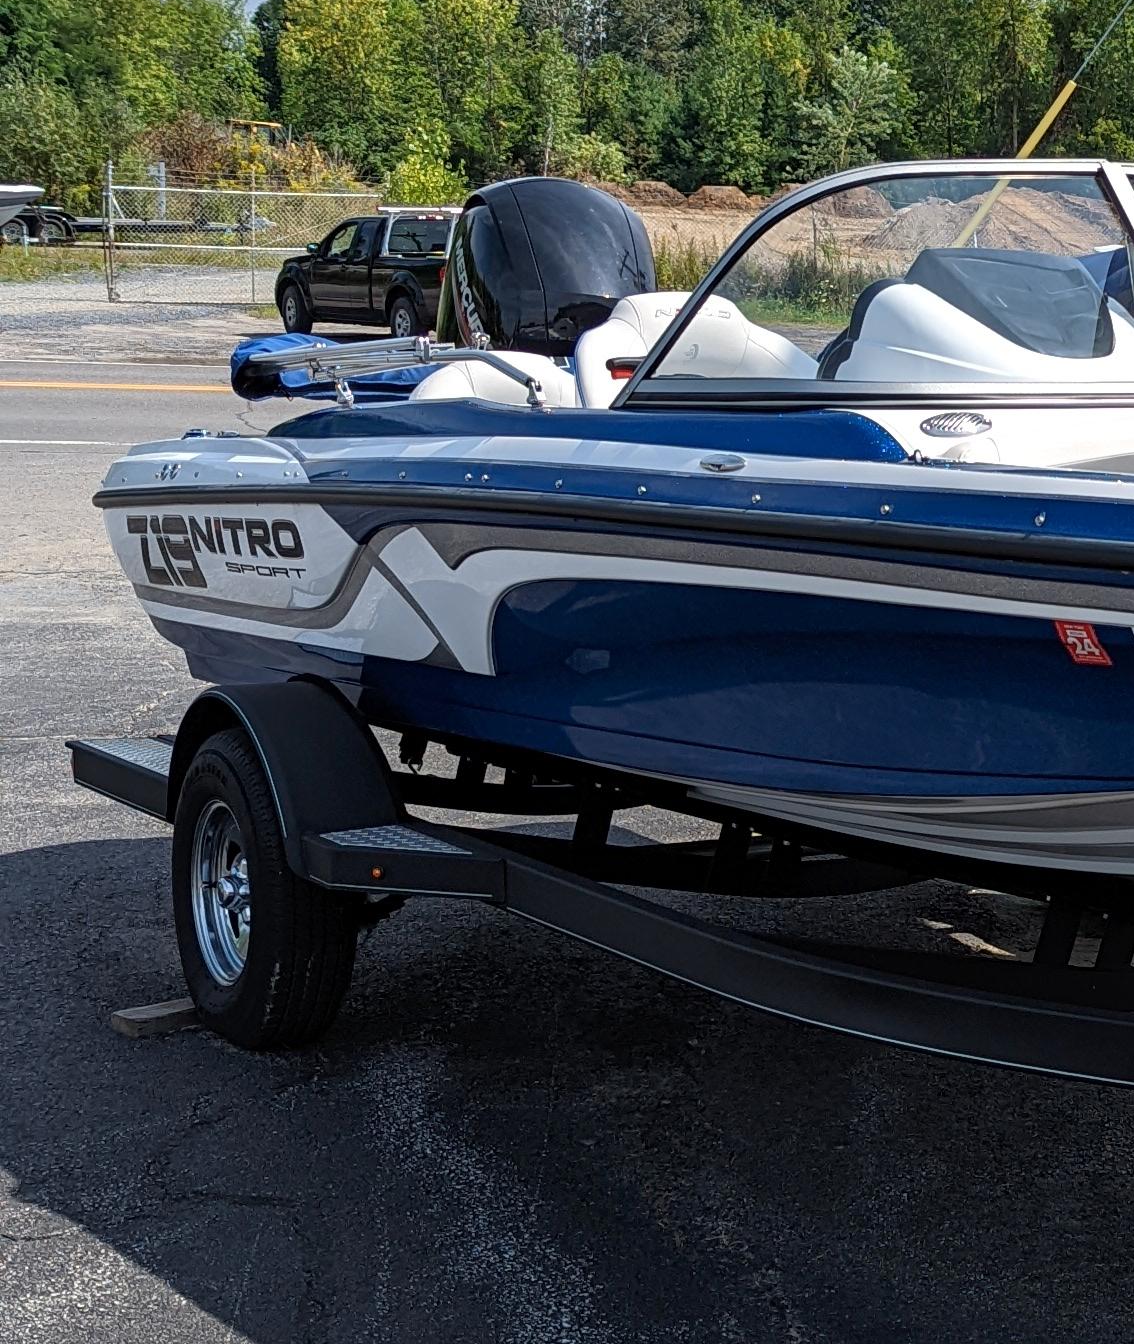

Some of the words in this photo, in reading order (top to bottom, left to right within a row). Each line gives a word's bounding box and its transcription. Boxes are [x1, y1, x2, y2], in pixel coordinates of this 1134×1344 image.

[455, 235, 485, 336] MERCUR
[187, 515, 305, 560] NITRO
[225, 561, 306, 580] SPORT
[1066, 636, 1101, 656] 24
